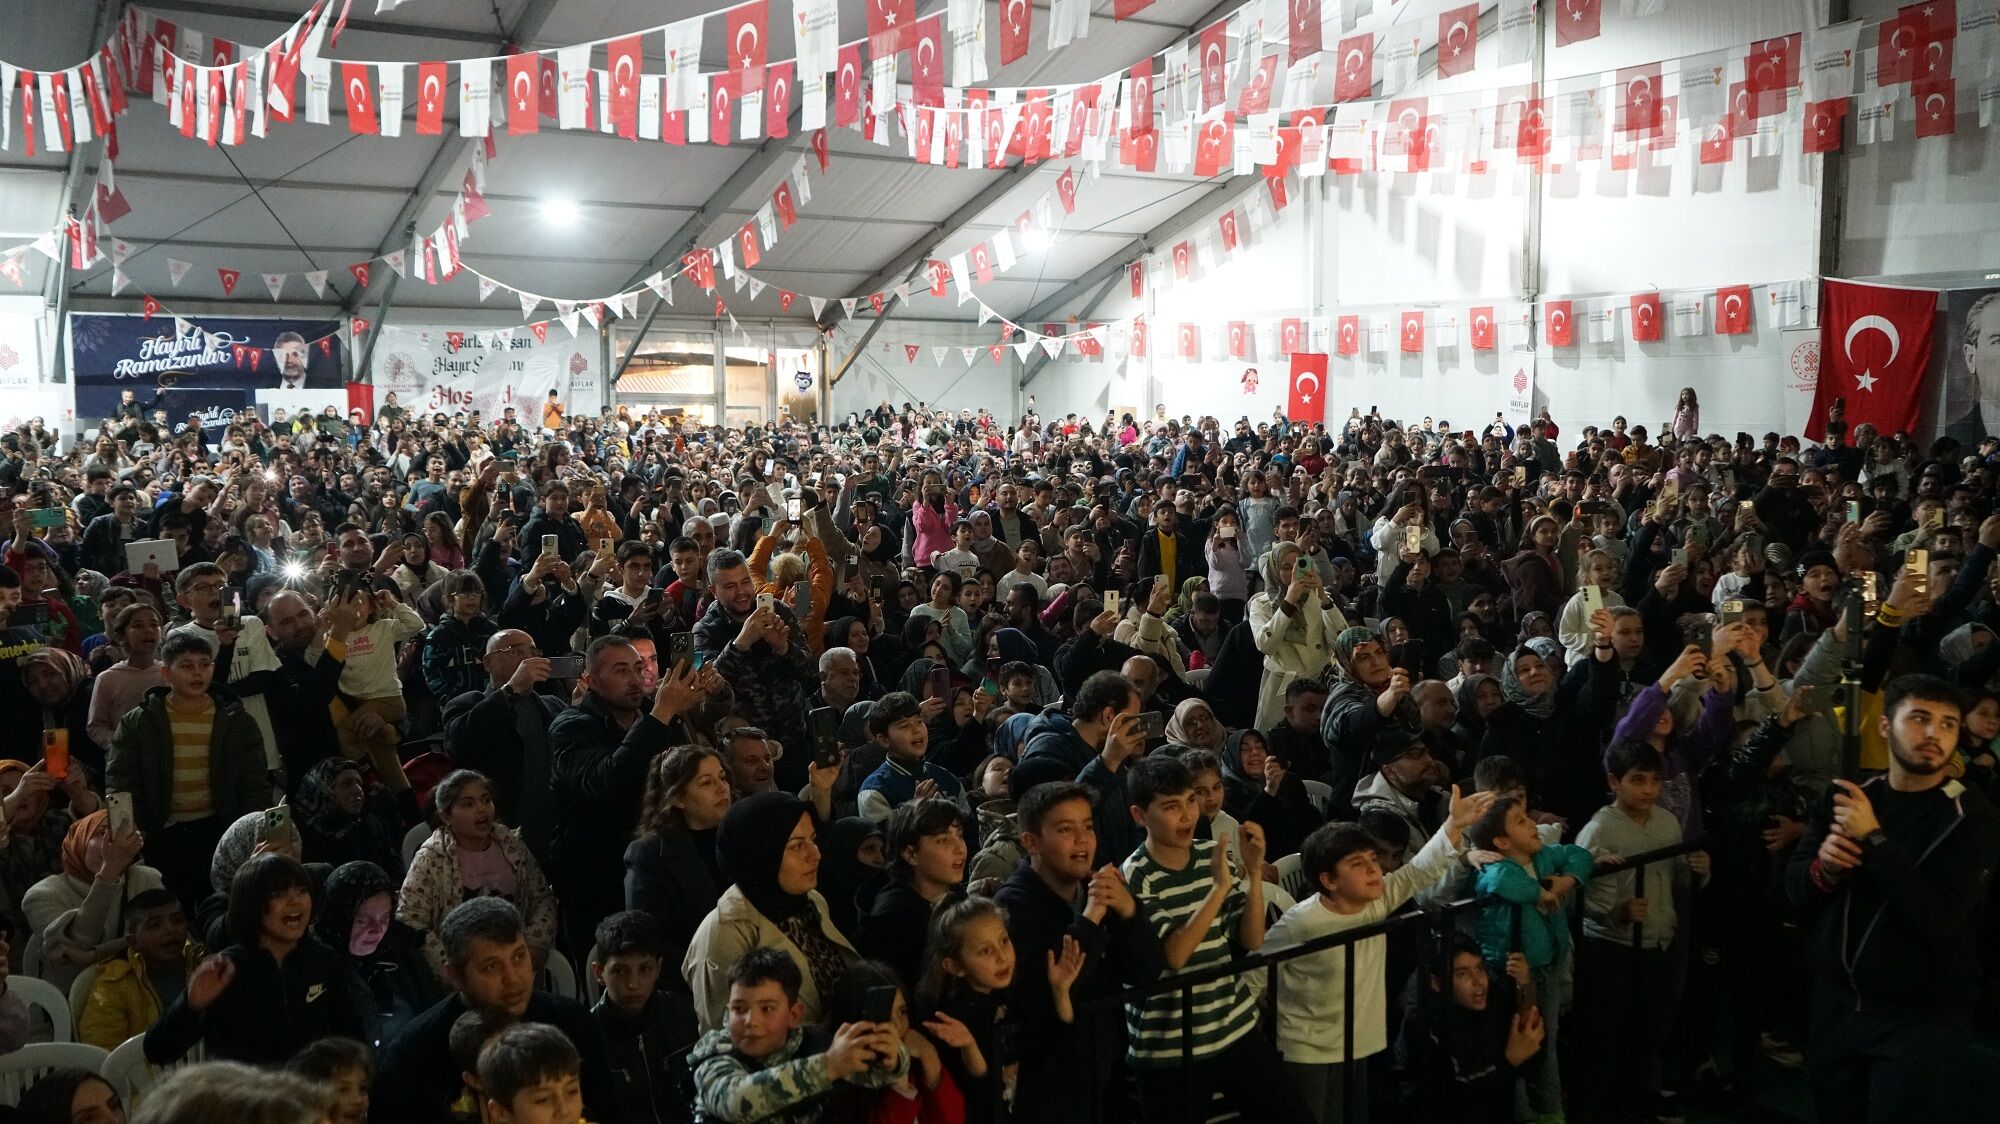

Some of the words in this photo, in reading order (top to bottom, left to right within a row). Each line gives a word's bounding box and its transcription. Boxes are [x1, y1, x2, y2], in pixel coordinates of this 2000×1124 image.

[139, 326, 202, 361] Hayırlı
[113, 345, 232, 379] Ramazanlar
[432, 356, 471, 377] Hayır
[429, 384, 473, 413] Hoş
